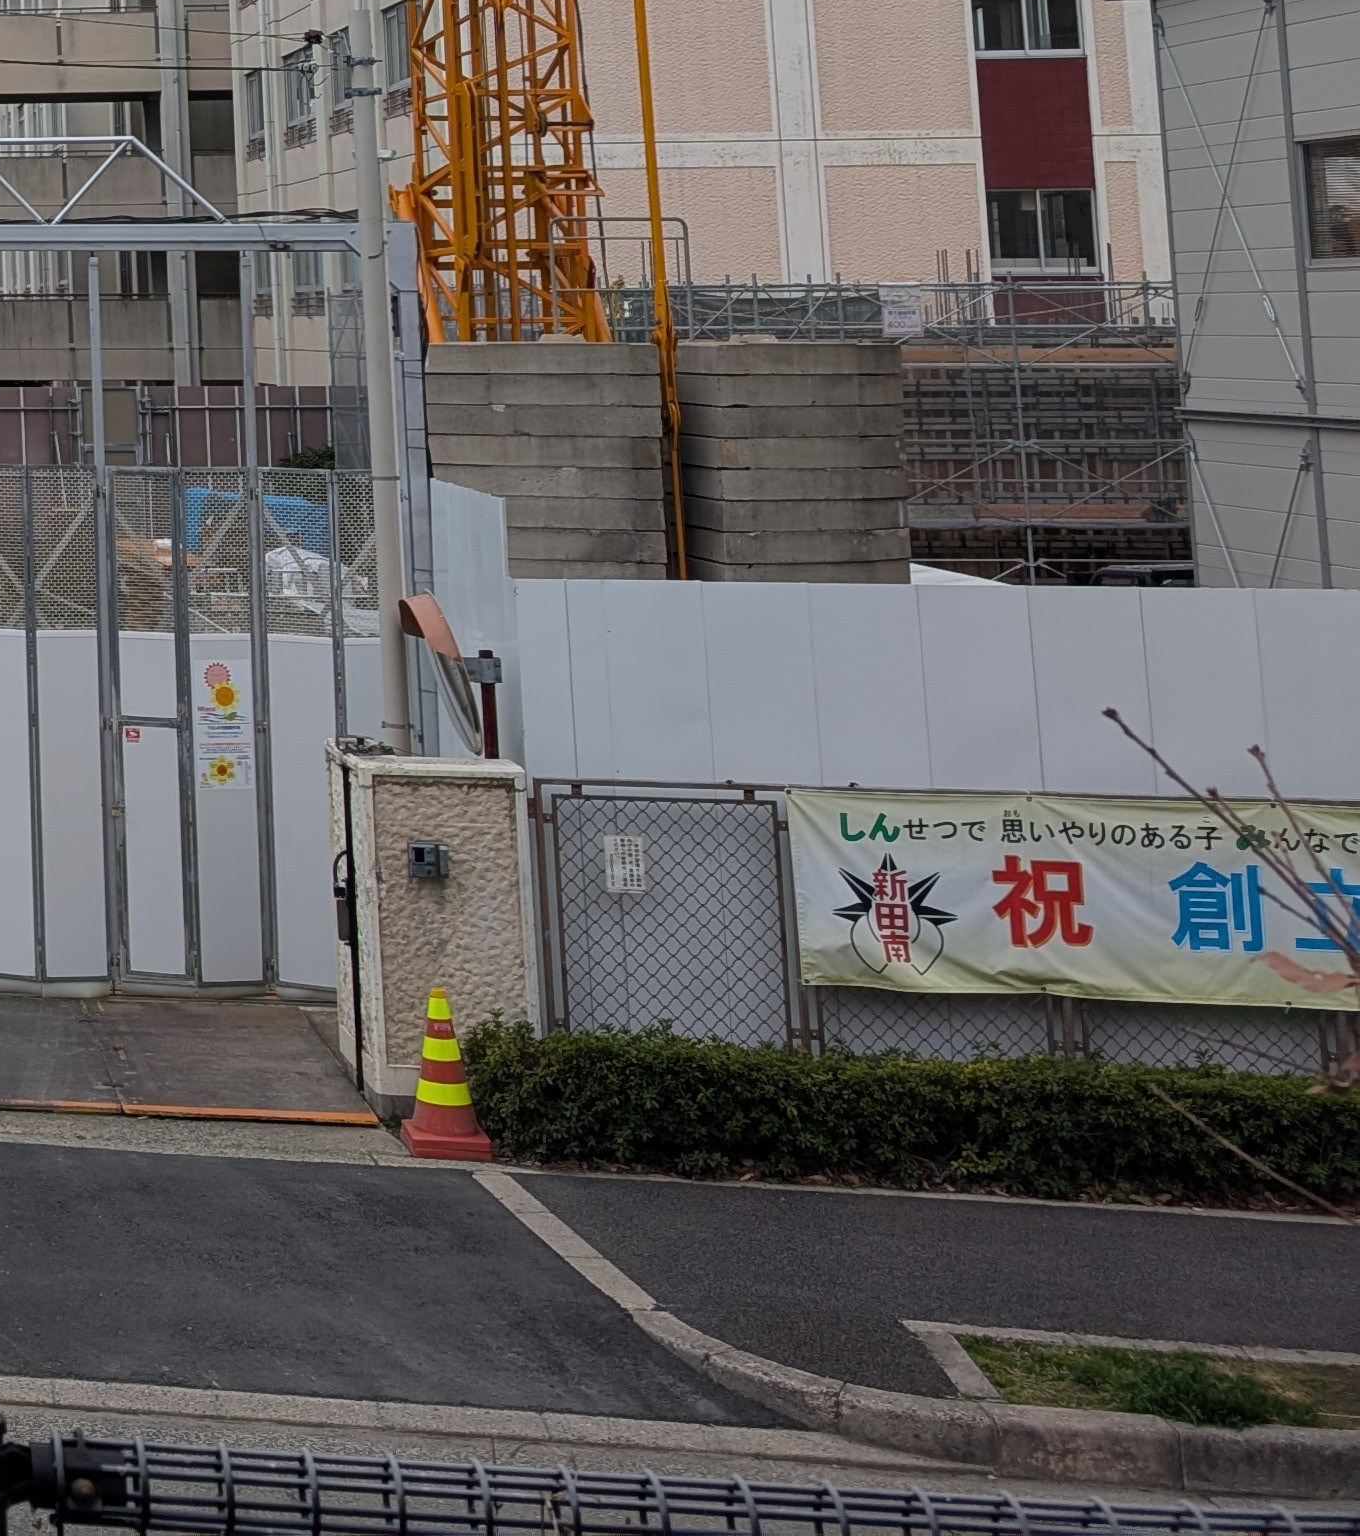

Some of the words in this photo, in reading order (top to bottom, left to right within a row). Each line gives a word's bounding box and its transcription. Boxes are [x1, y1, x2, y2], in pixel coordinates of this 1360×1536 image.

[887, 321, 905, 329] 400
[839, 811, 986, 843] しんせつで
[1001, 817, 1223, 851] 思いやりのある子
[1236, 824, 1359, 855] みんなで
[872, 867, 911, 964] 新田南
[992, 854, 1094, 949] 祝
